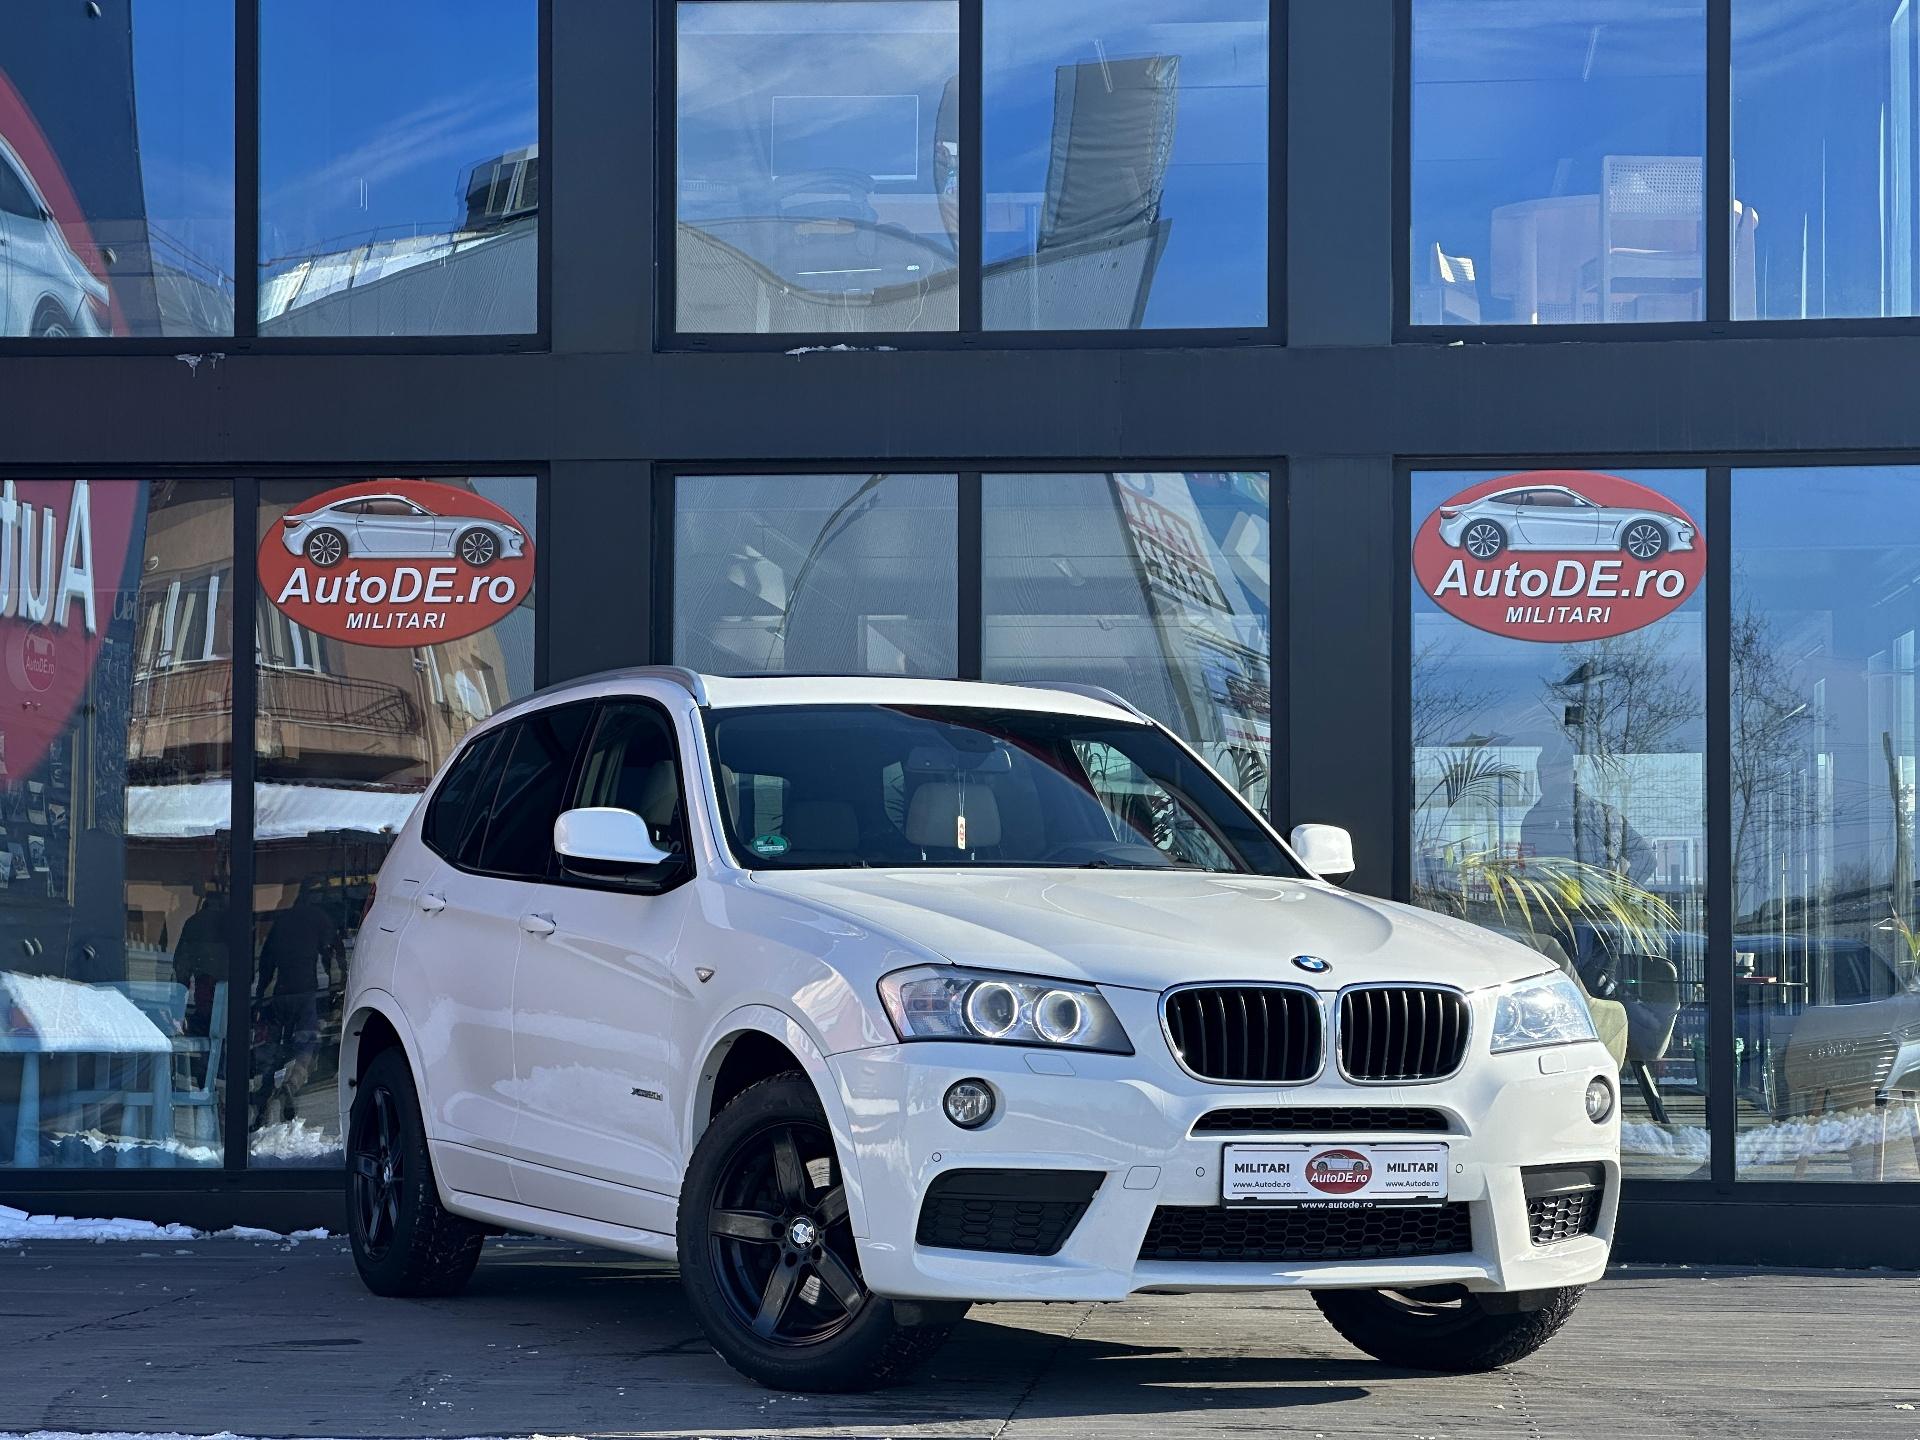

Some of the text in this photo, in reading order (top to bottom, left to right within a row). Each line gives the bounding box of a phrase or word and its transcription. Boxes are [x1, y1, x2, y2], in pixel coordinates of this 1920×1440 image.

[1434, 559, 1685, 598] AutoDE.ro
[277, 568, 515, 604] AutoDE.ro
[346, 613, 446, 629] MILITARI
[1505, 607, 1611, 623] MILITARI
[1234, 1163, 1290, 1174] MILITARI
[1387, 1162, 1438, 1173] MILITARI
[1310, 1172, 1368, 1184] AutoDE.ro
[1301, 1200, 1373, 1209] www.autode.ro
